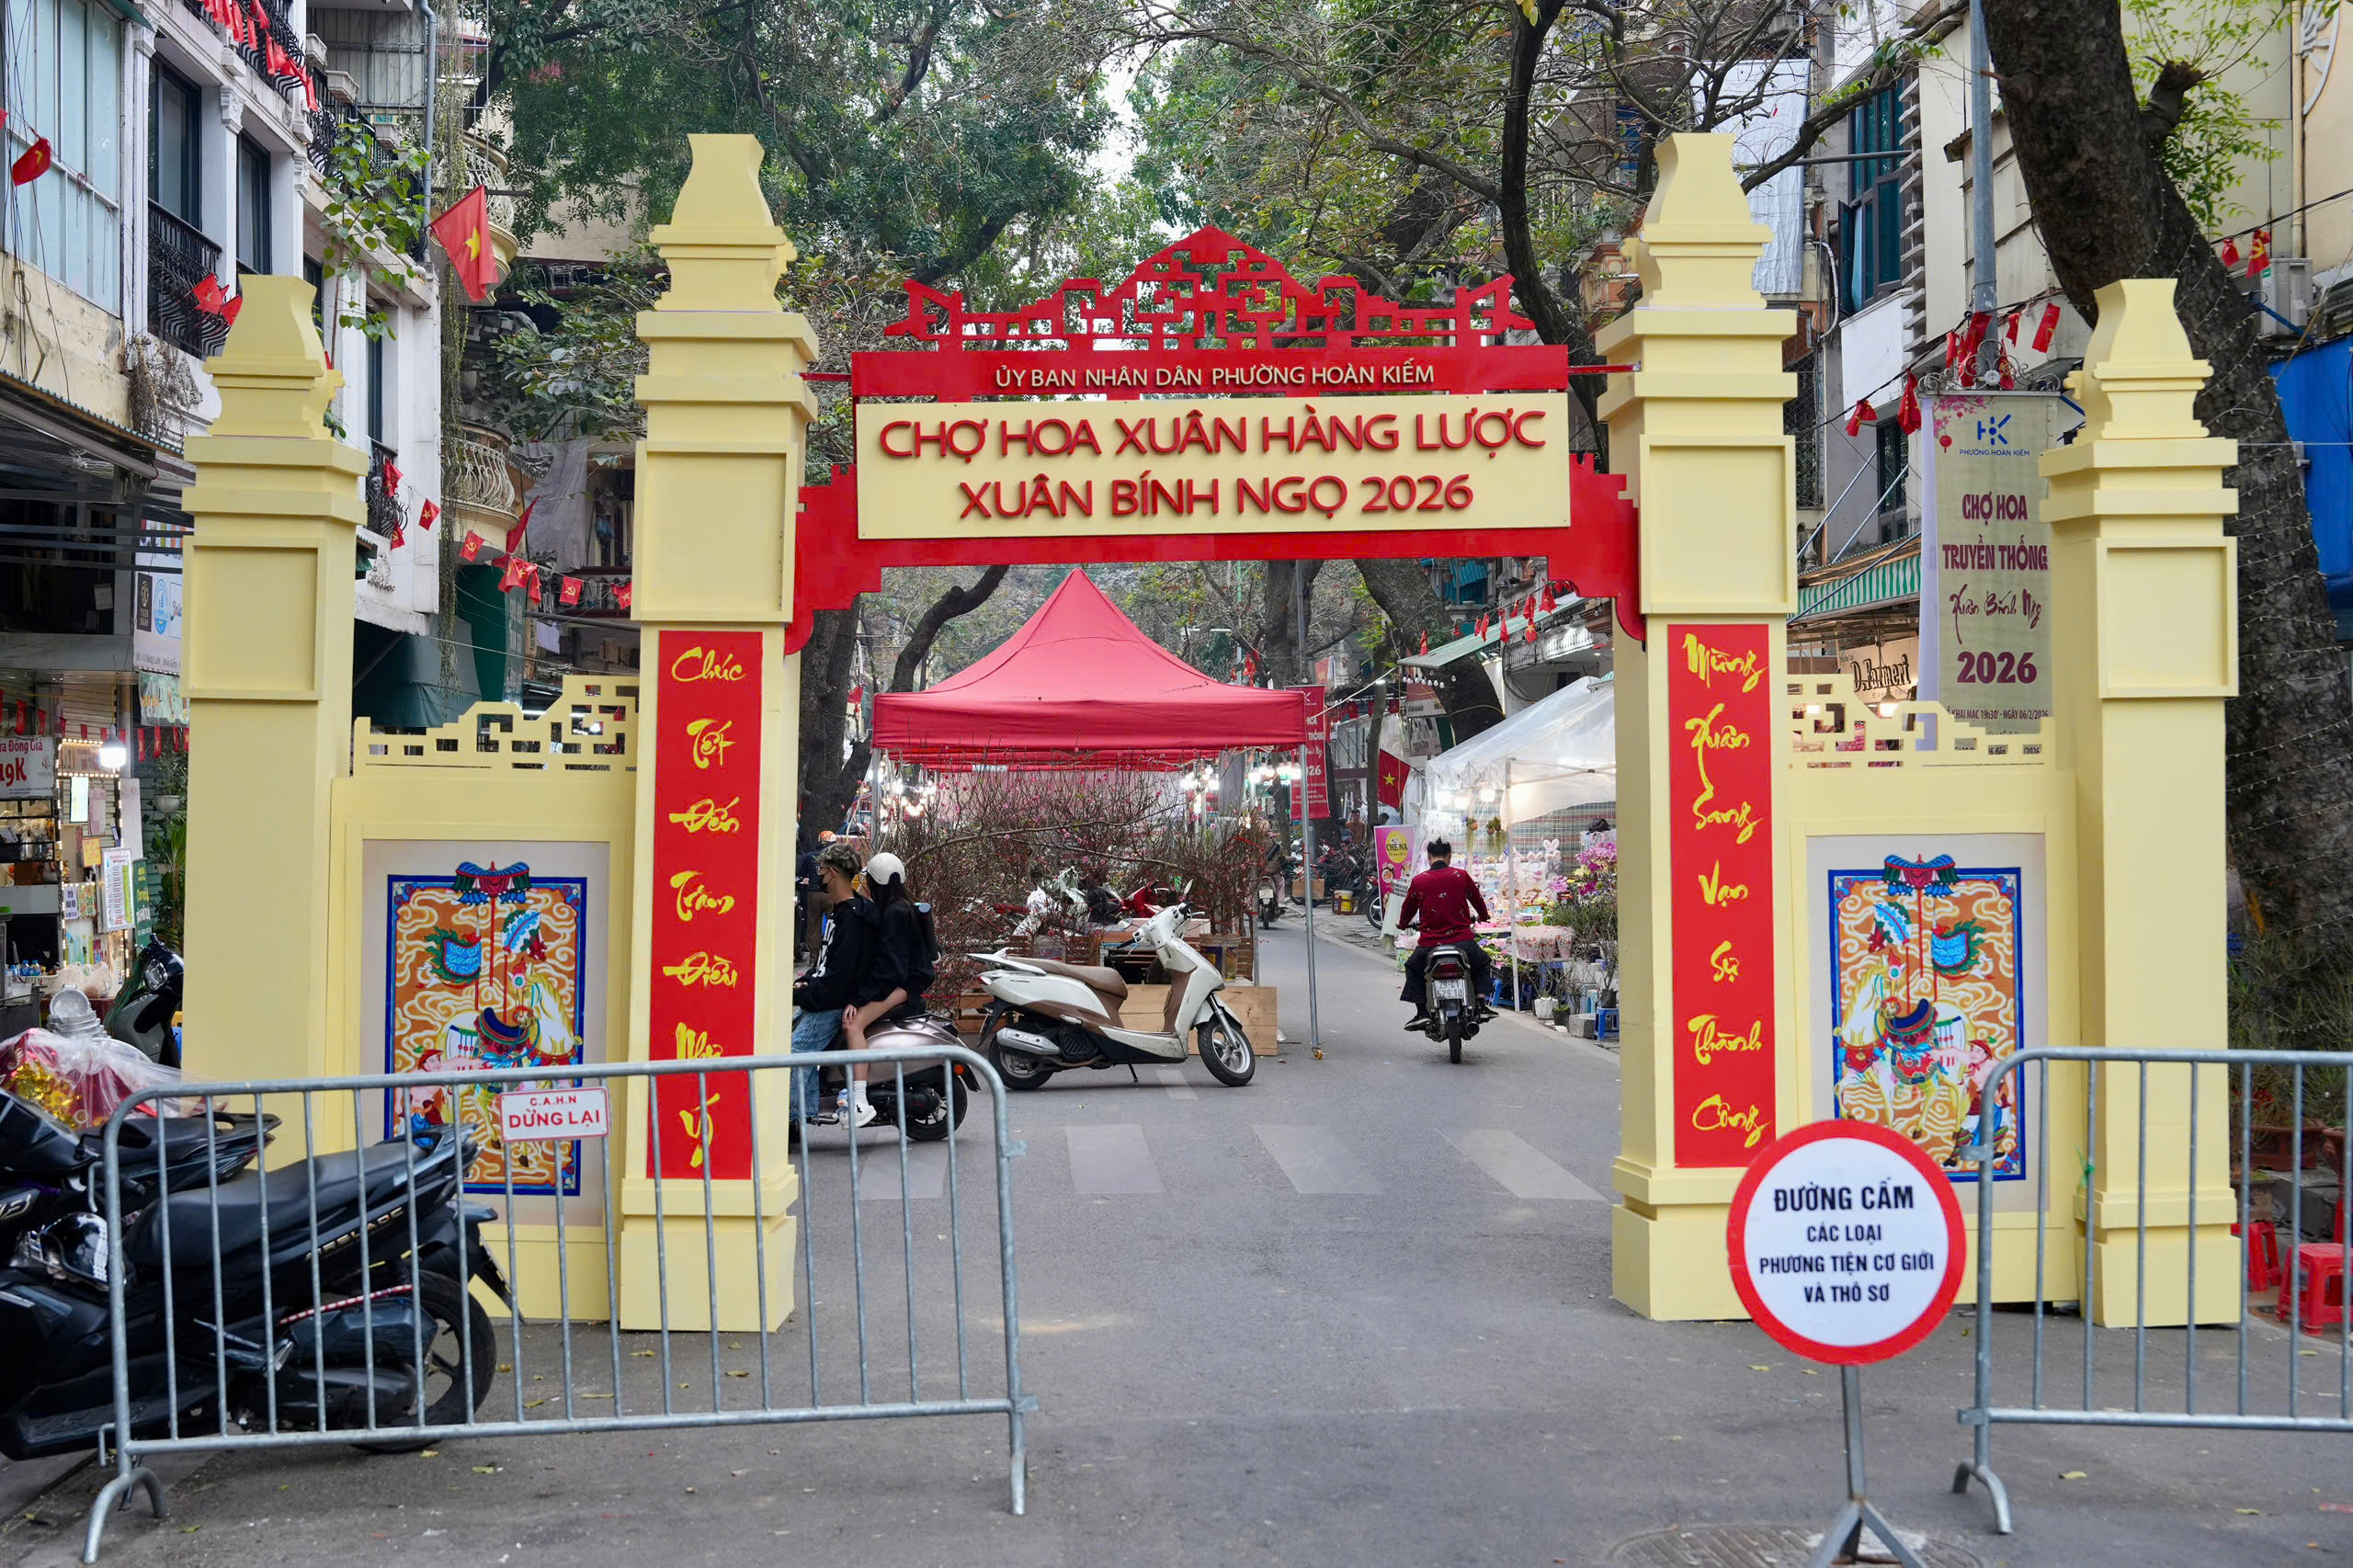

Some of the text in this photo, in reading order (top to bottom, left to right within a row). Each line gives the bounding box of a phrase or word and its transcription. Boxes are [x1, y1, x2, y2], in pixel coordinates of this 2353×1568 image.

[995, 358, 1435, 387] ỦY BAN NHÂN DÂN PHƯỜNG HOÀN KIẾM
[880, 404, 1547, 464] CHỢ HOA XUÂN HÀNG LƯỢC
[1960, 447, 2030, 457] PHƯỜNG HOÀN KIẾM
[960, 470, 1474, 519] XUÂN BÍNH NGỌ 2026
[1962, 491, 2028, 525] CHỢ HOA
[1942, 534, 2049, 571] TRUYỀN THỐNG
[1984, 590, 2017, 617] Bính
[672, 647, 745, 682] Chúc
[1683, 632, 1766, 693] Mừng
[1958, 651, 2038, 684] 2026
[1967, 709, 1980, 722] MẠC
[2003, 707, 2018, 720] NGÀY
[688, 720, 733, 769] Tết
[1686, 703, 1750, 793] Xuân
[669, 796, 740, 833] Đến
[1698, 859, 1748, 907] Vạn
[1711, 940, 1739, 983] Sự
[1688, 1014, 1762, 1065] Thành
[530, 1095, 577, 1106] C.A.H.N
[509, 1108, 600, 1129] DỪNG LẠI
[1693, 1094, 1767, 1148] Công
[1774, 1177, 1914, 1212] ĐƯỜNG CẤM
[1807, 1221, 1881, 1245] CÁC LOẠI
[1760, 1249, 1934, 1277] PHƯƠNG TIỆN CƠ GIỚI
[1804, 1281, 1890, 1302] VÀ THÔ SƠ
